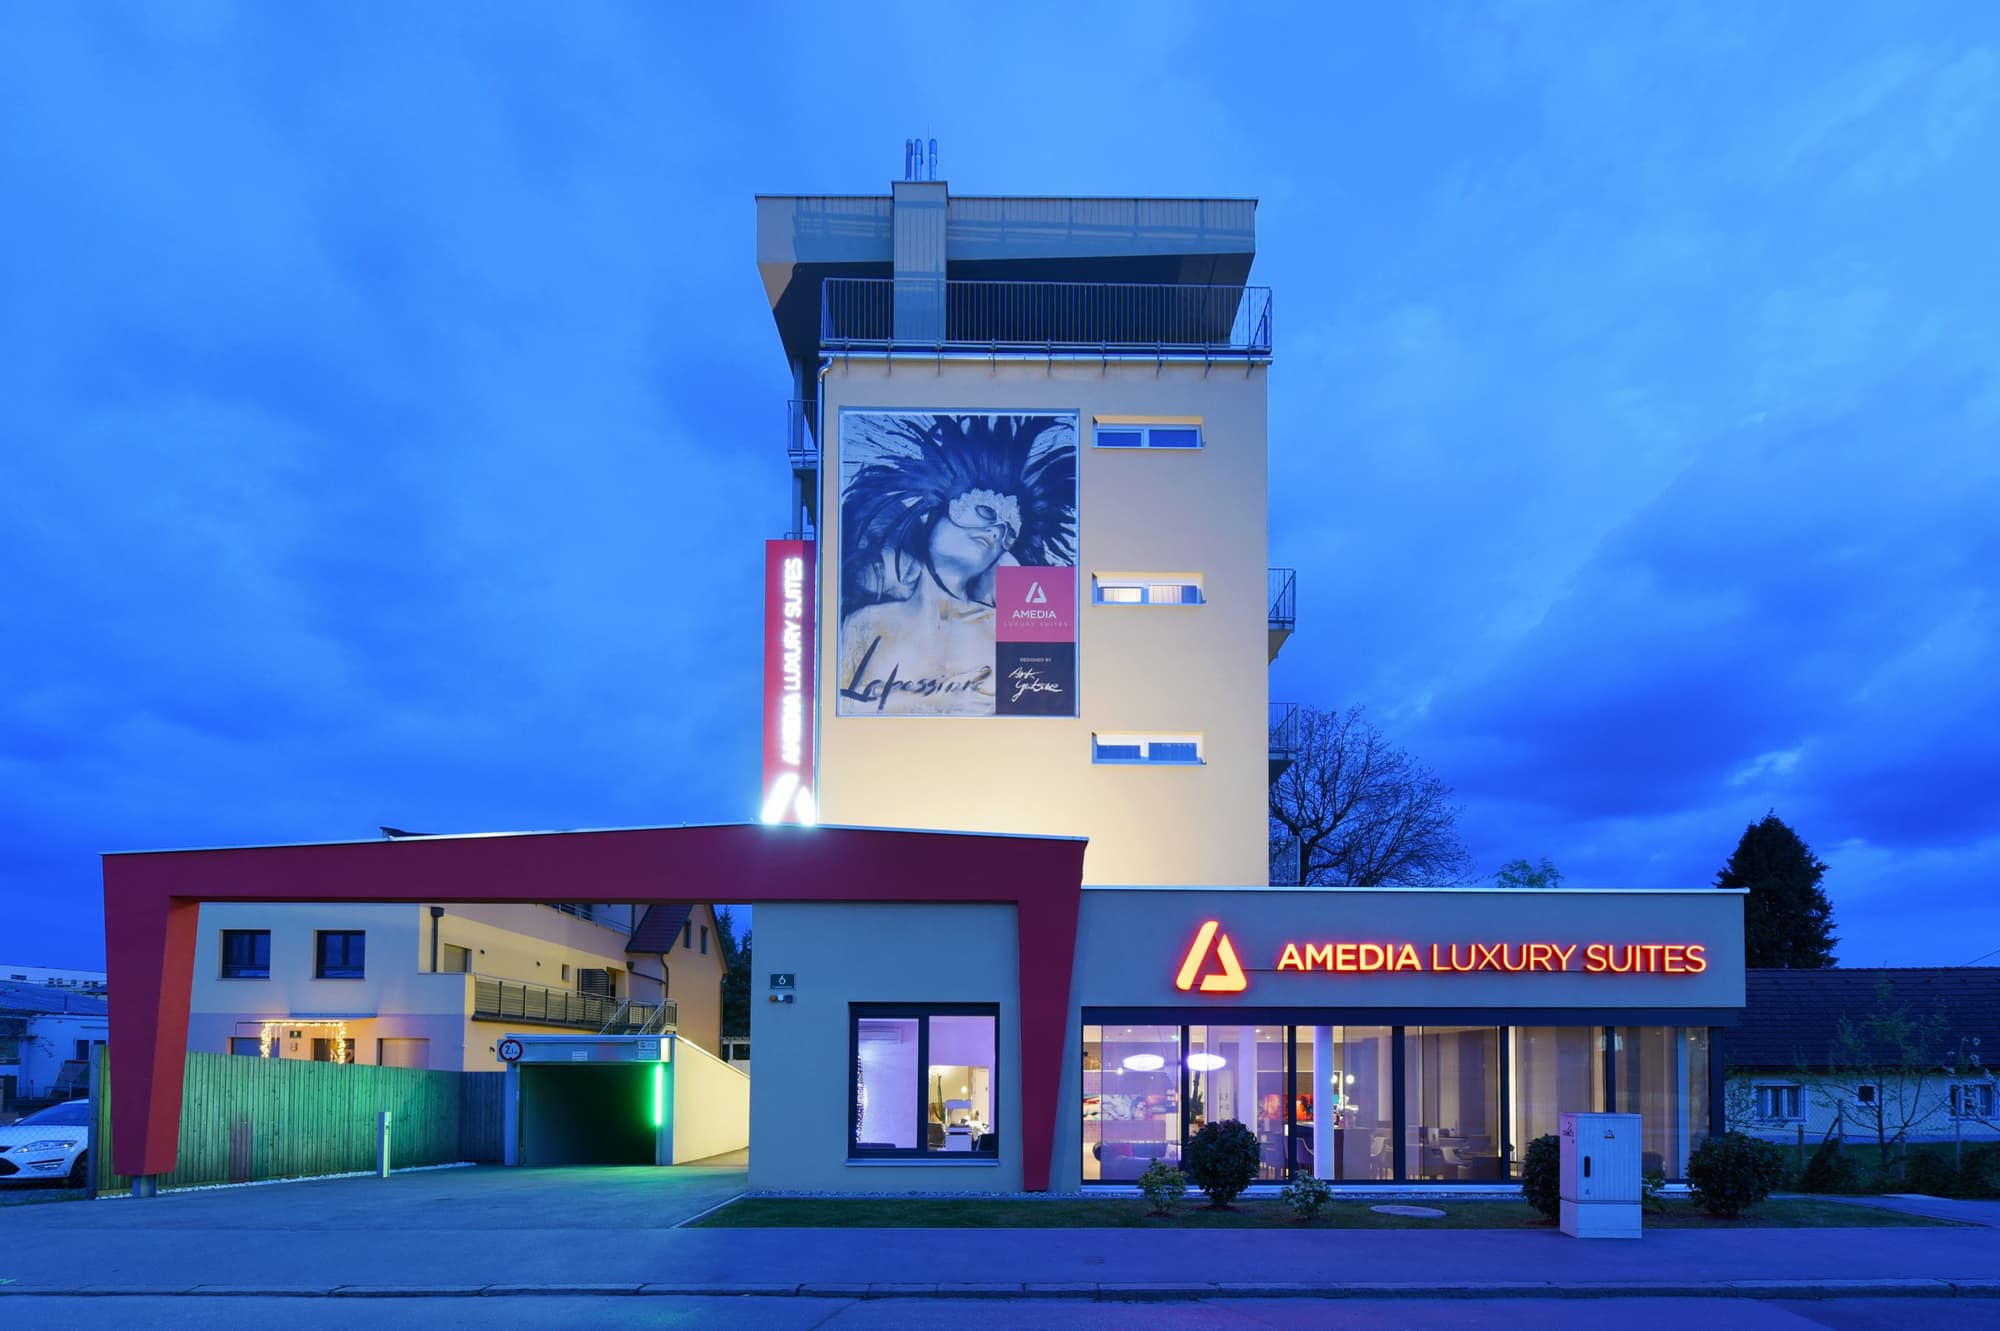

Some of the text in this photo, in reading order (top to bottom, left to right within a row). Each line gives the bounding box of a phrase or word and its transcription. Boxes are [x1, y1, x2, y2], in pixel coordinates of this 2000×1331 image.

[1012, 609, 1057, 619] AMEDIA
[782, 557, 803, 765] AMIA LUXURY SUITES
[1277, 943, 1706, 972] AMEDIA LUXURY SUITES
[778, 974, 786, 985] 6
